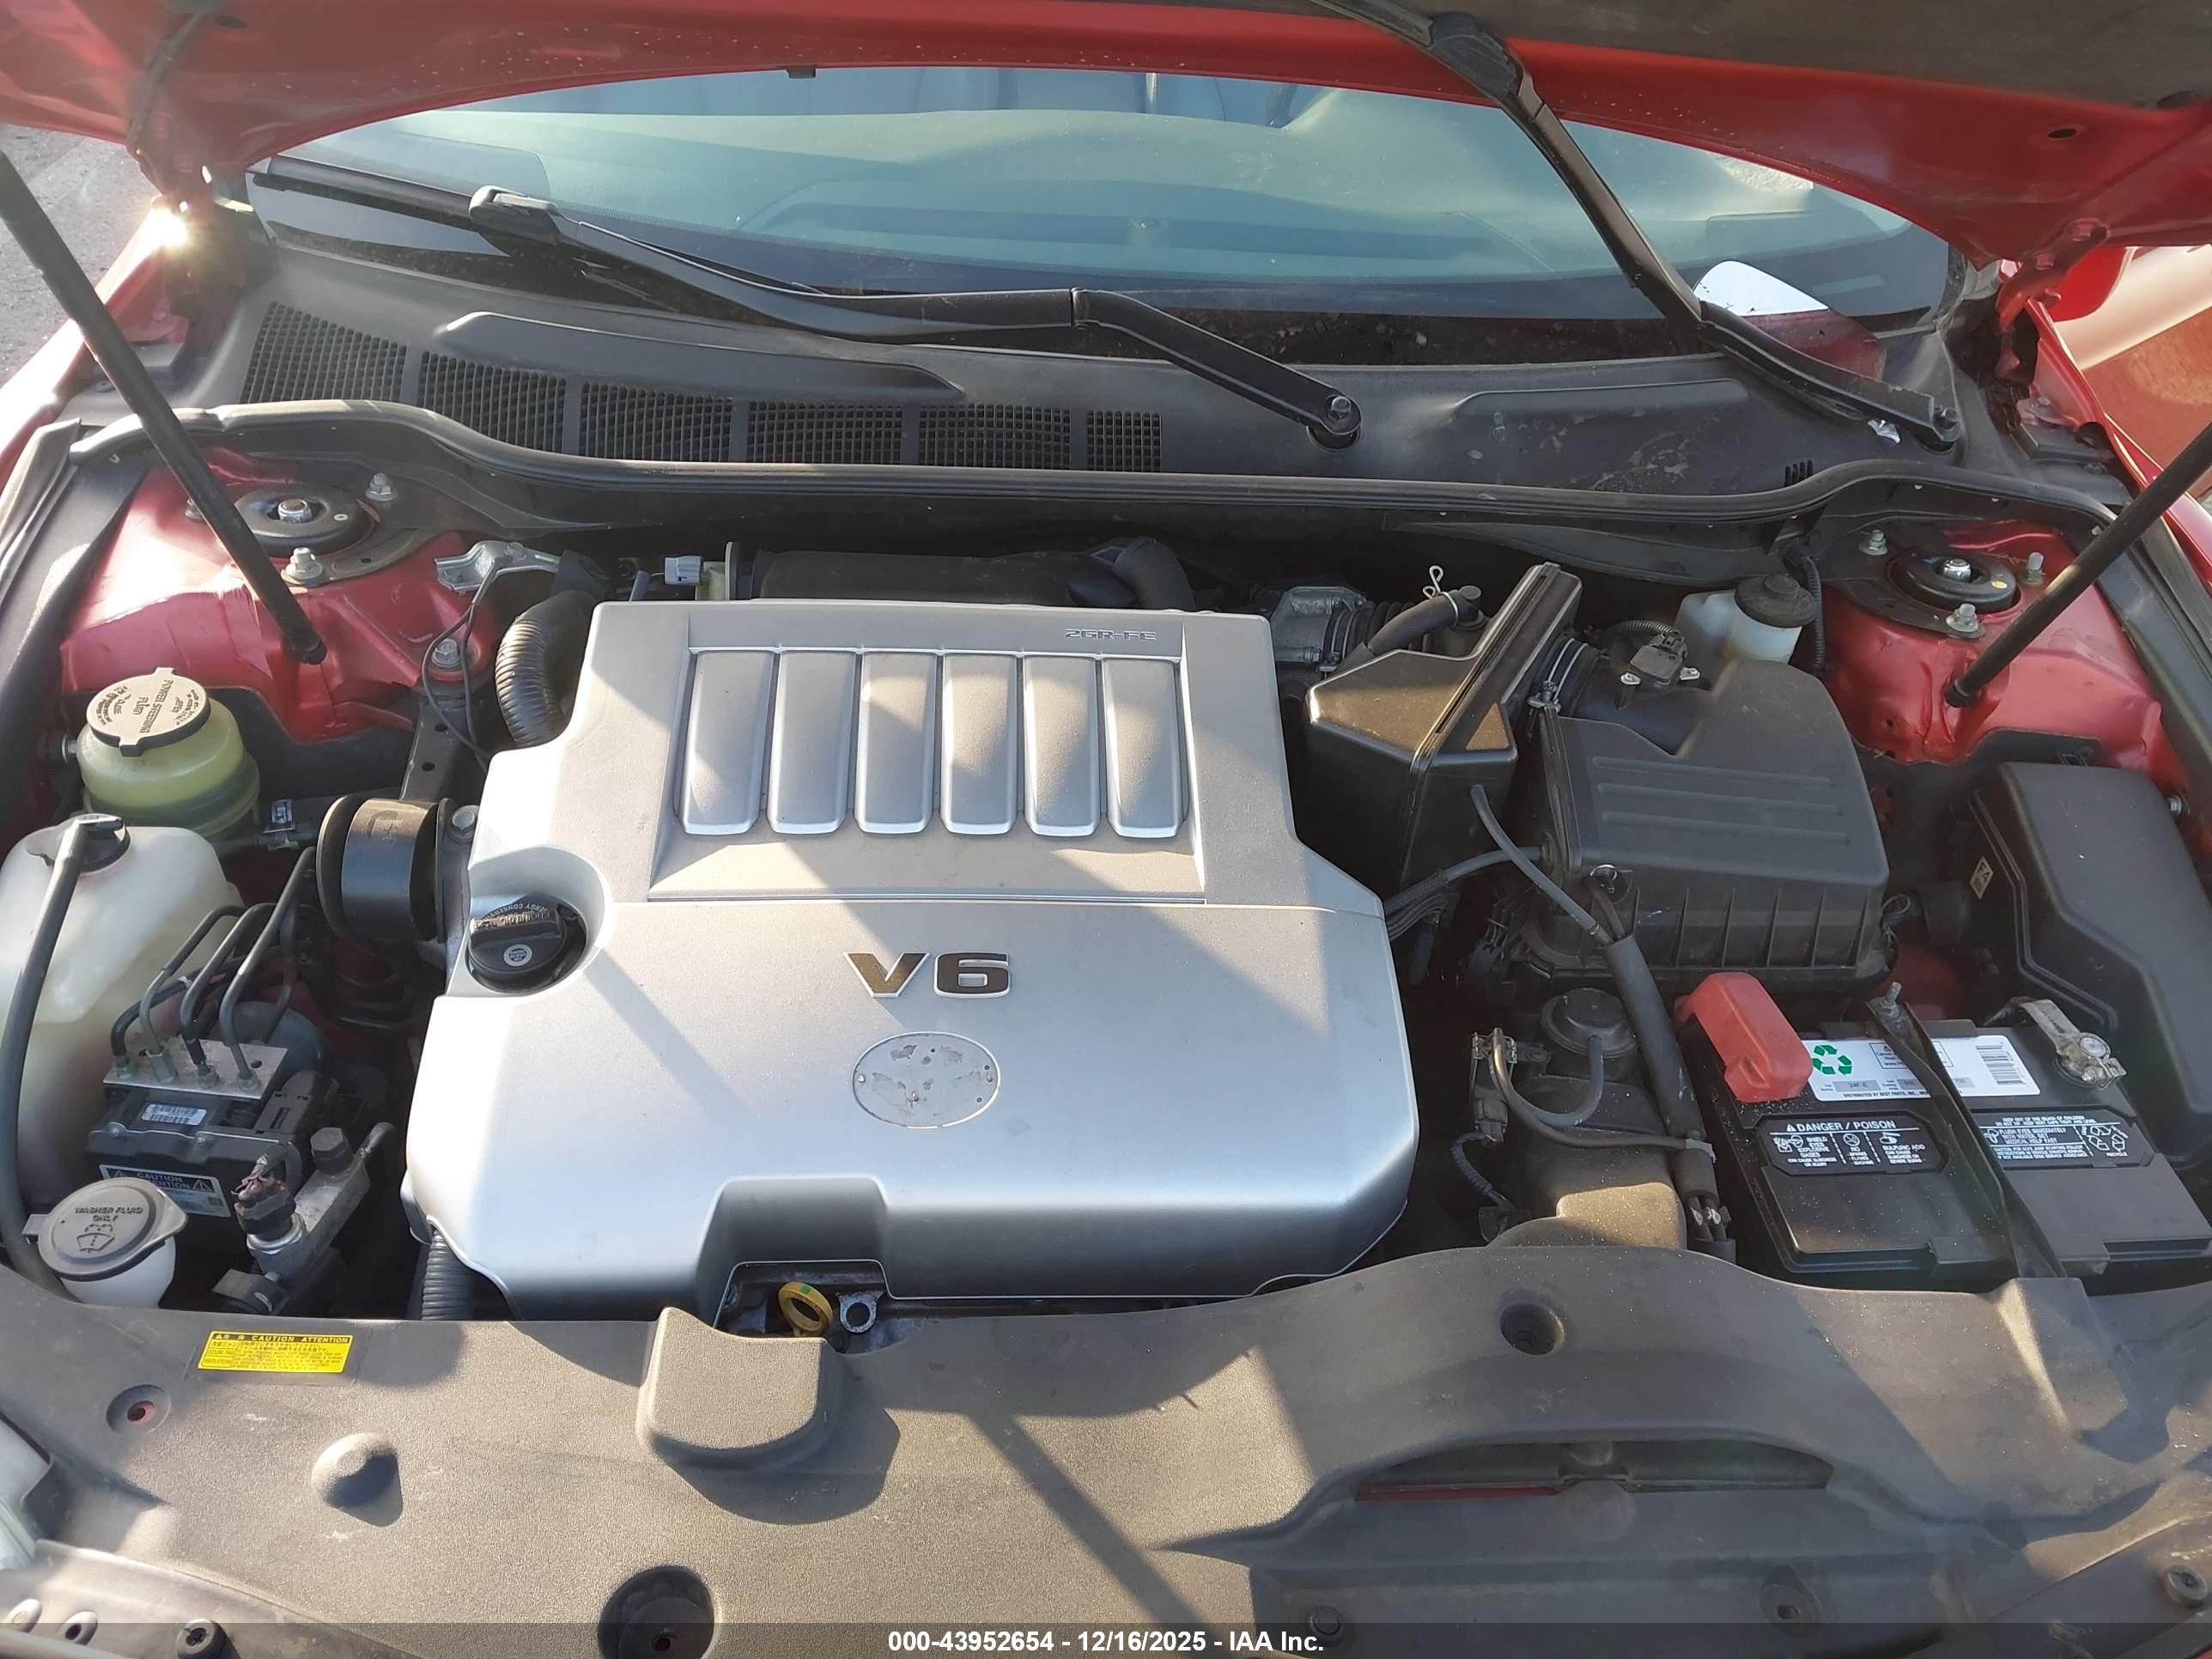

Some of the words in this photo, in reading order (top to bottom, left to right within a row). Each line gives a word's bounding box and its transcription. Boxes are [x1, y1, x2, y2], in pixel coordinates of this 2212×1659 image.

[1065, 628, 1157, 641] 2GR-FE
[842, 951, 1011, 998] V6
[1796, 1122, 1843, 1132] DANGER
[1845, 1121, 1850, 1130] /
[1855, 1120, 1897, 1130] POISON
[137, 1171, 183, 1183] CAUTION
